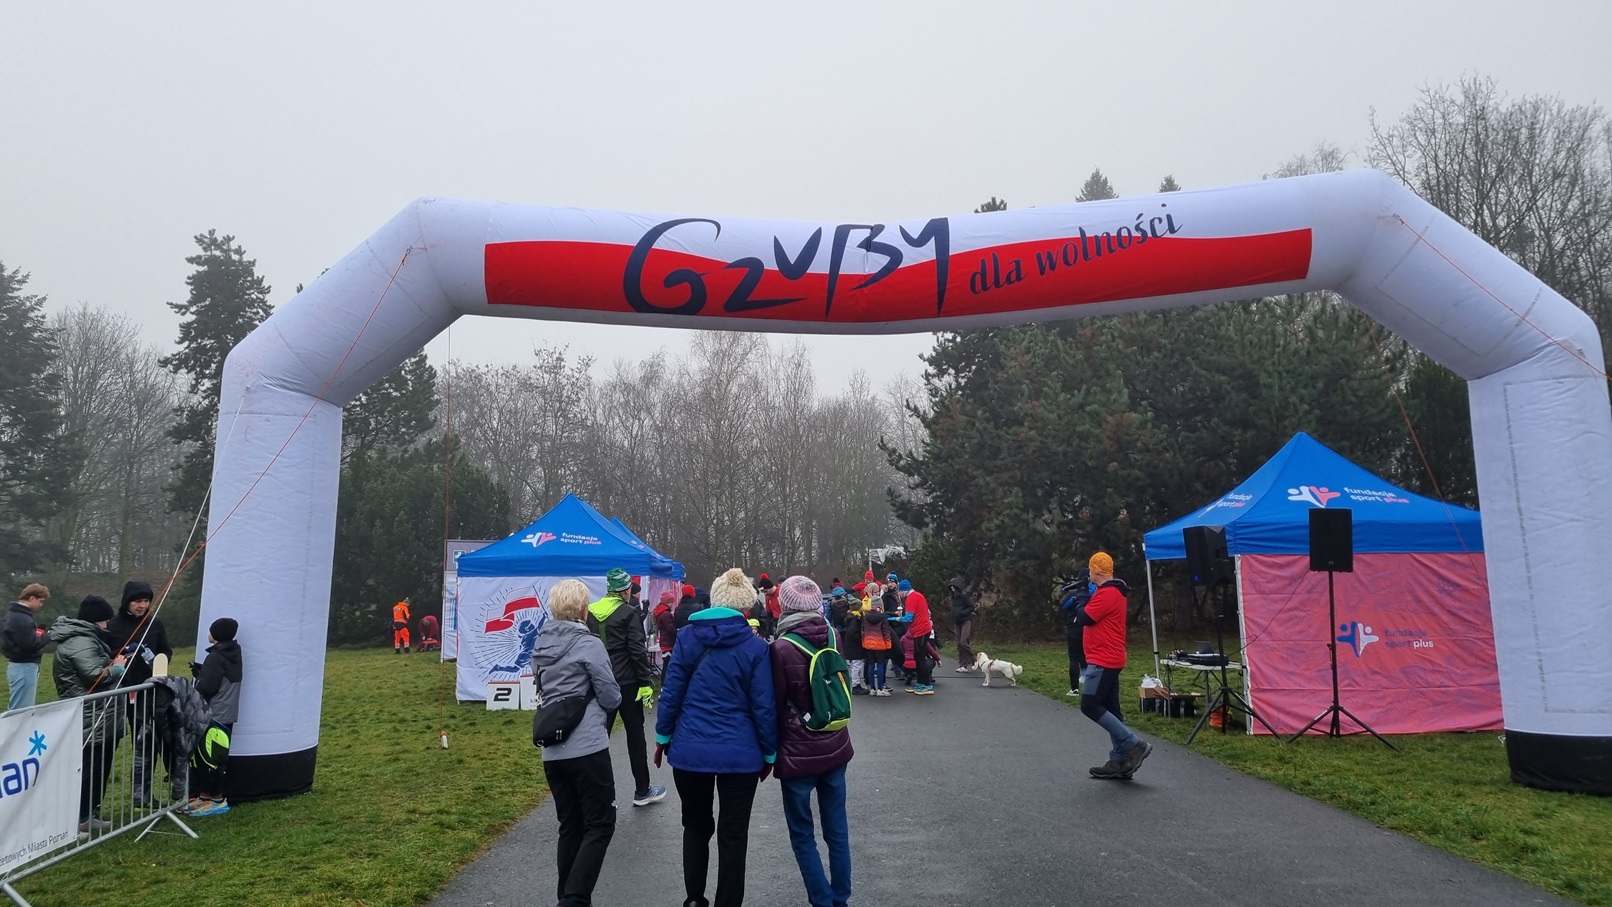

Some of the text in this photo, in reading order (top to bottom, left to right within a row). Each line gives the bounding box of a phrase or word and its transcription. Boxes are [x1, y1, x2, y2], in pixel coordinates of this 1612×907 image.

[969, 252, 1028, 295] dla
[1035, 203, 1184, 276] wolności
[1344, 487, 1397, 498] fundacja
[562, 532, 598, 542] fundacja
[1385, 628, 1428, 639] fundacja
[1385, 639, 1434, 649] sport plus
[493, 687, 513, 702] 2
[27, 841, 48, 853] Miasta
